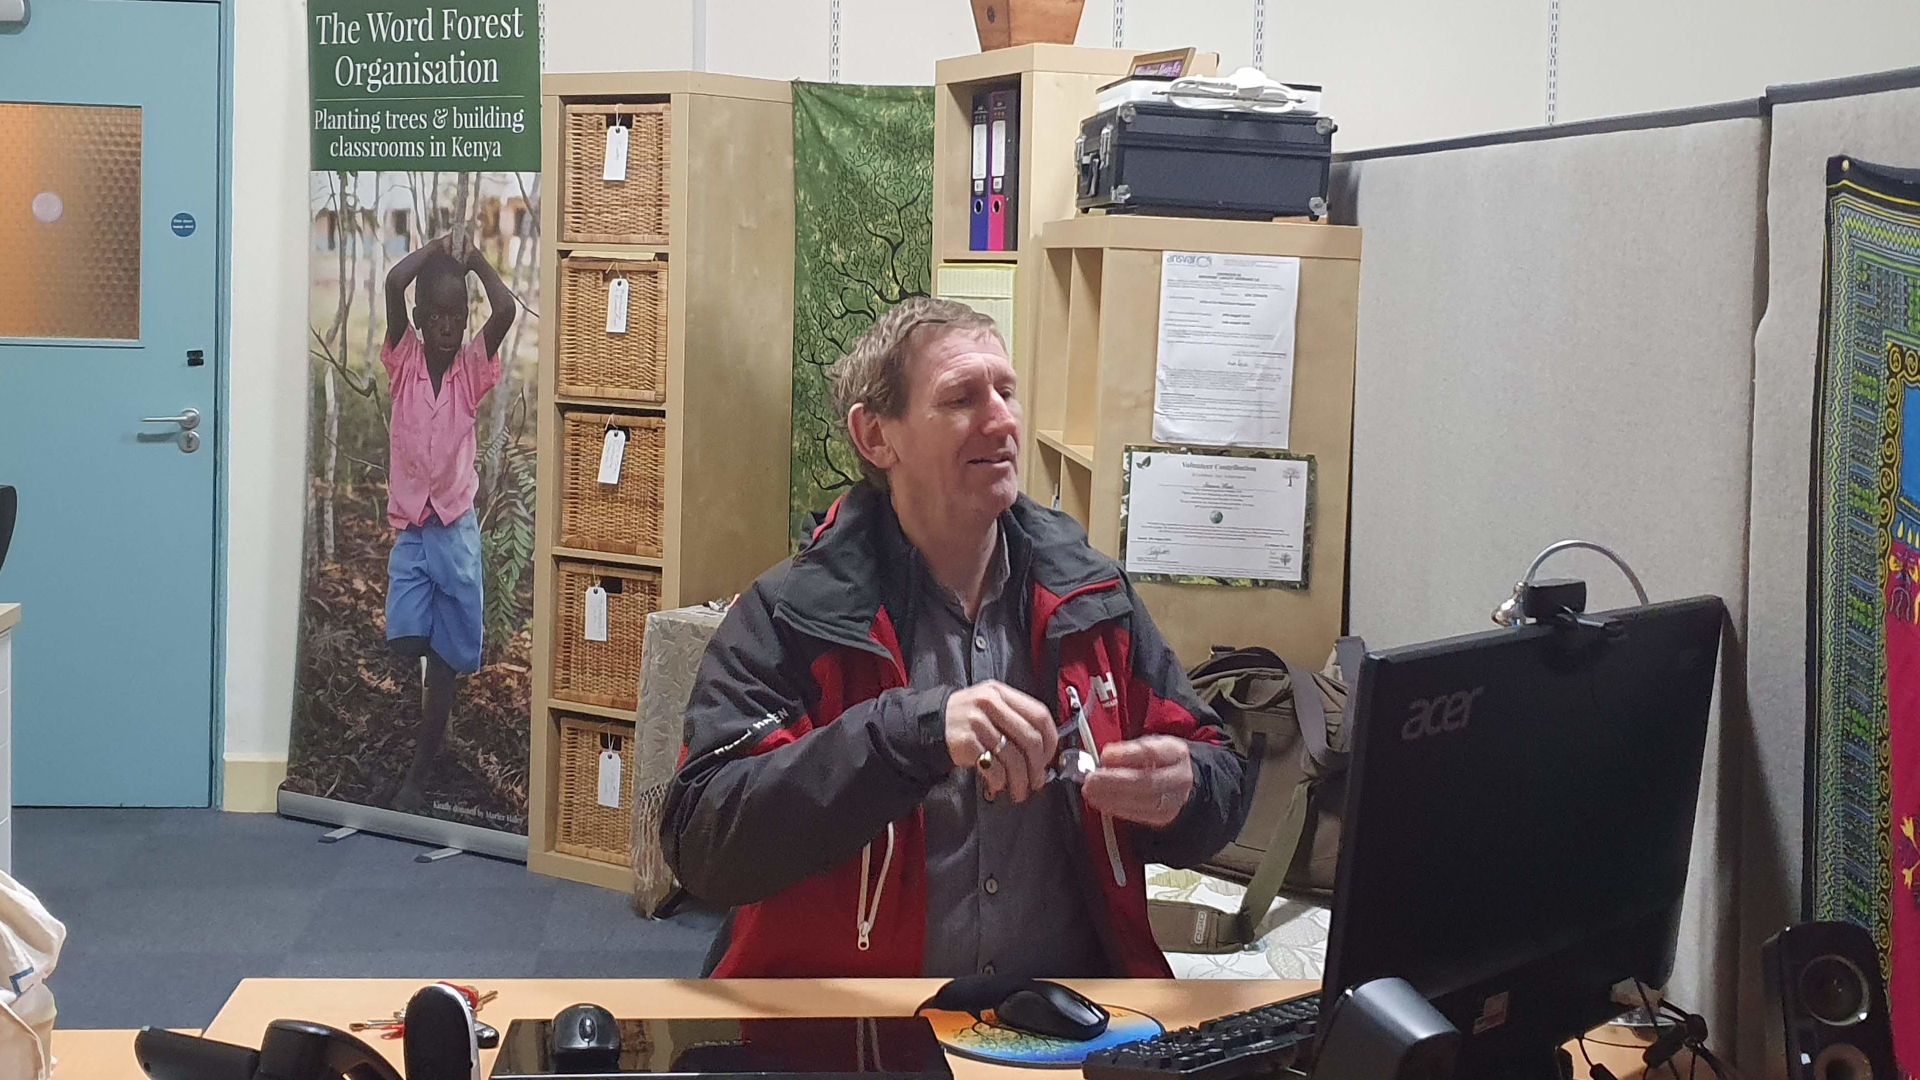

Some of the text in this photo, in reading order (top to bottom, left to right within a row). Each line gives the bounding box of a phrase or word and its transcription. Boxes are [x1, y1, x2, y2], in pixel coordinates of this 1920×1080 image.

[316, 7, 525, 45] The Word Forest
[335, 50, 499, 93] Organisation
[314, 106, 525, 134] Planting trees & building
[330, 135, 502, 161] classrooms in Kenya
[1401, 686, 1485, 740] acer
